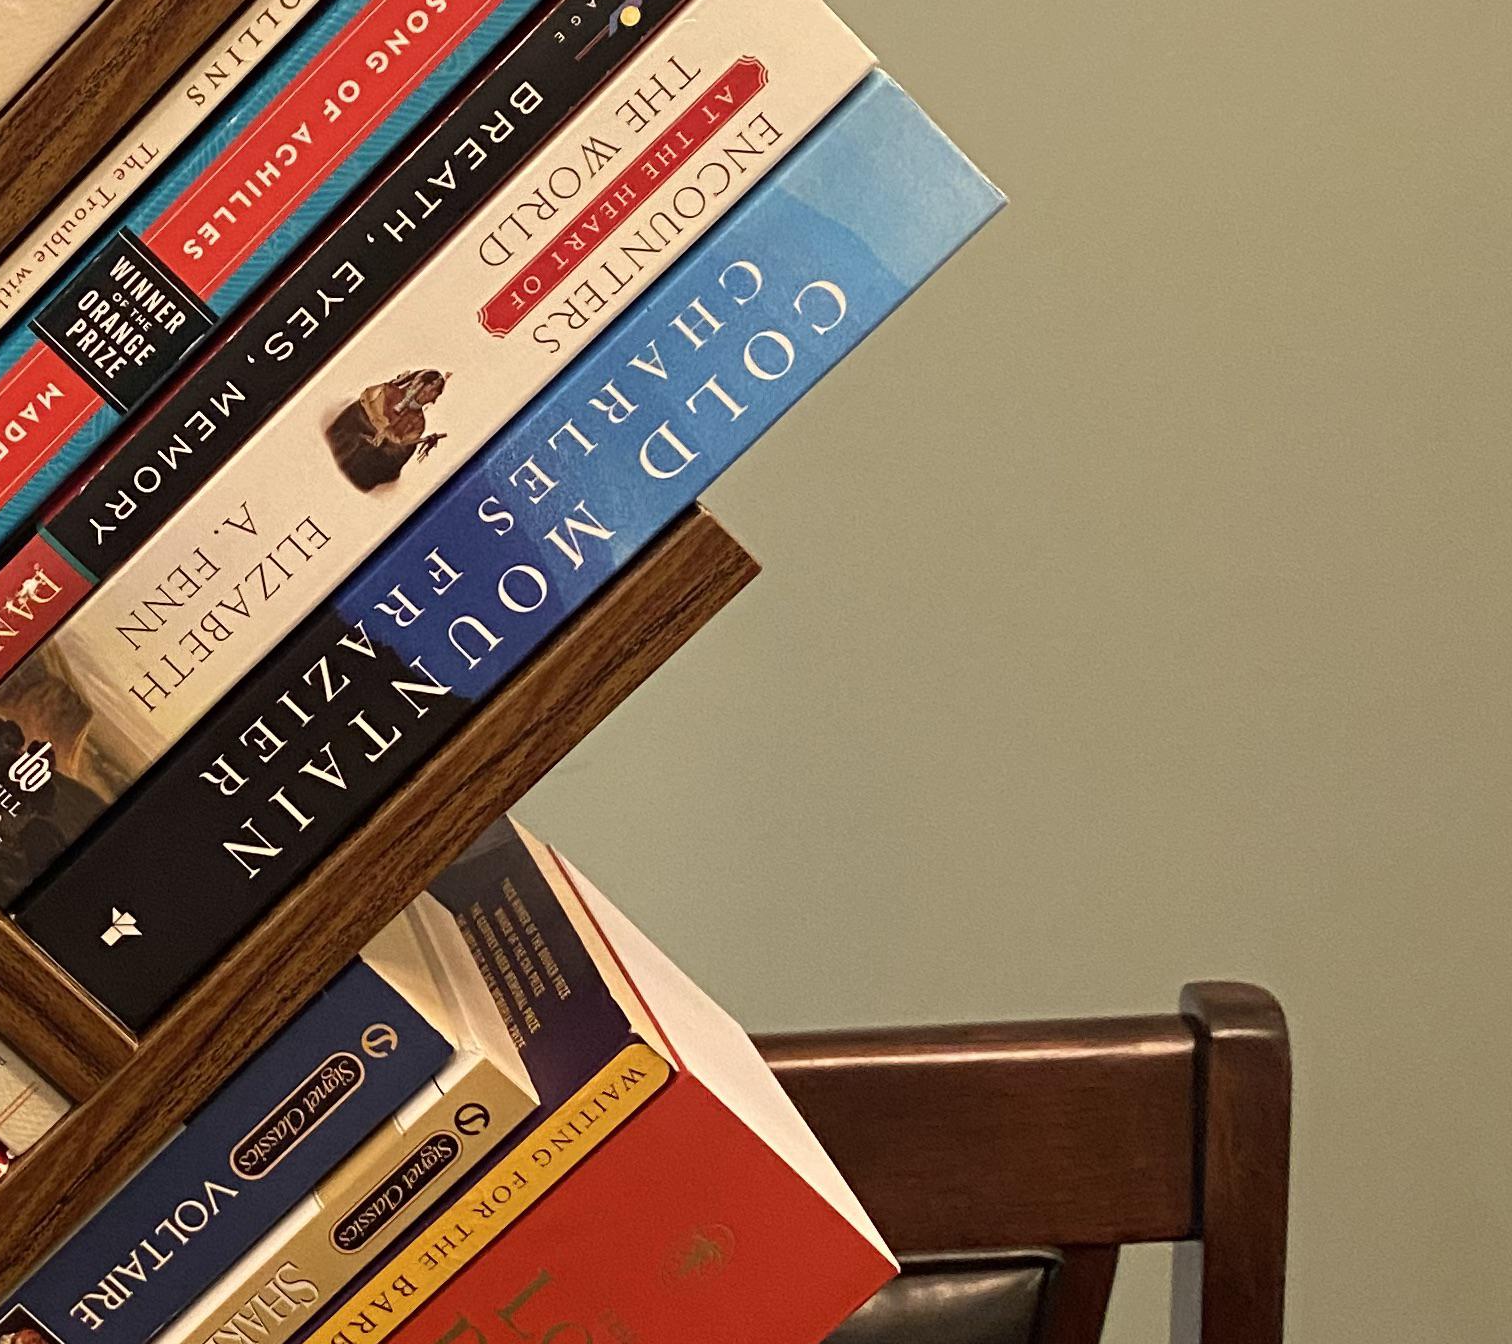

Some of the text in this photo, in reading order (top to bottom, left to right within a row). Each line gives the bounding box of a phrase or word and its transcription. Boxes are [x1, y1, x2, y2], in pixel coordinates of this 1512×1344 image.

[323, 79, 360, 123] OF
[113, 142, 160, 181] The
[183, 122, 312, 260] ACHILLES
[479, 55, 702, 267] THE WORLD
[510, 85, 734, 310] AT THE HEART OF
[33, 186, 117, 263] Trouble
[532, 111, 783, 354] ENCOUNTERS
[65, 317, 128, 379] PRIZE
[77, 289, 157, 367] ORANGE
[89, 81, 544, 546] BREATH, EYES, MEMORY
[109, 255, 186, 335] WINNER
[112, 292, 153, 332] OF THE
[115, 500, 258, 651] A. FENN
[198, 260, 763, 796] CHARLES FRAZIER
[222, 280, 847, 879] COLD MOUNTAIN
[128, 515, 332, 713] ELIZABETH
[236, 1057, 356, 1172] Signet Classics
[531, 1068, 647, 1168] WAITING
[335, 1135, 453, 1247] Signet Classics
[421, 1223, 474, 1267] THE
[471, 1170, 528, 1219] FOR
[69, 1181, 239, 1331] VOLTAIRE
